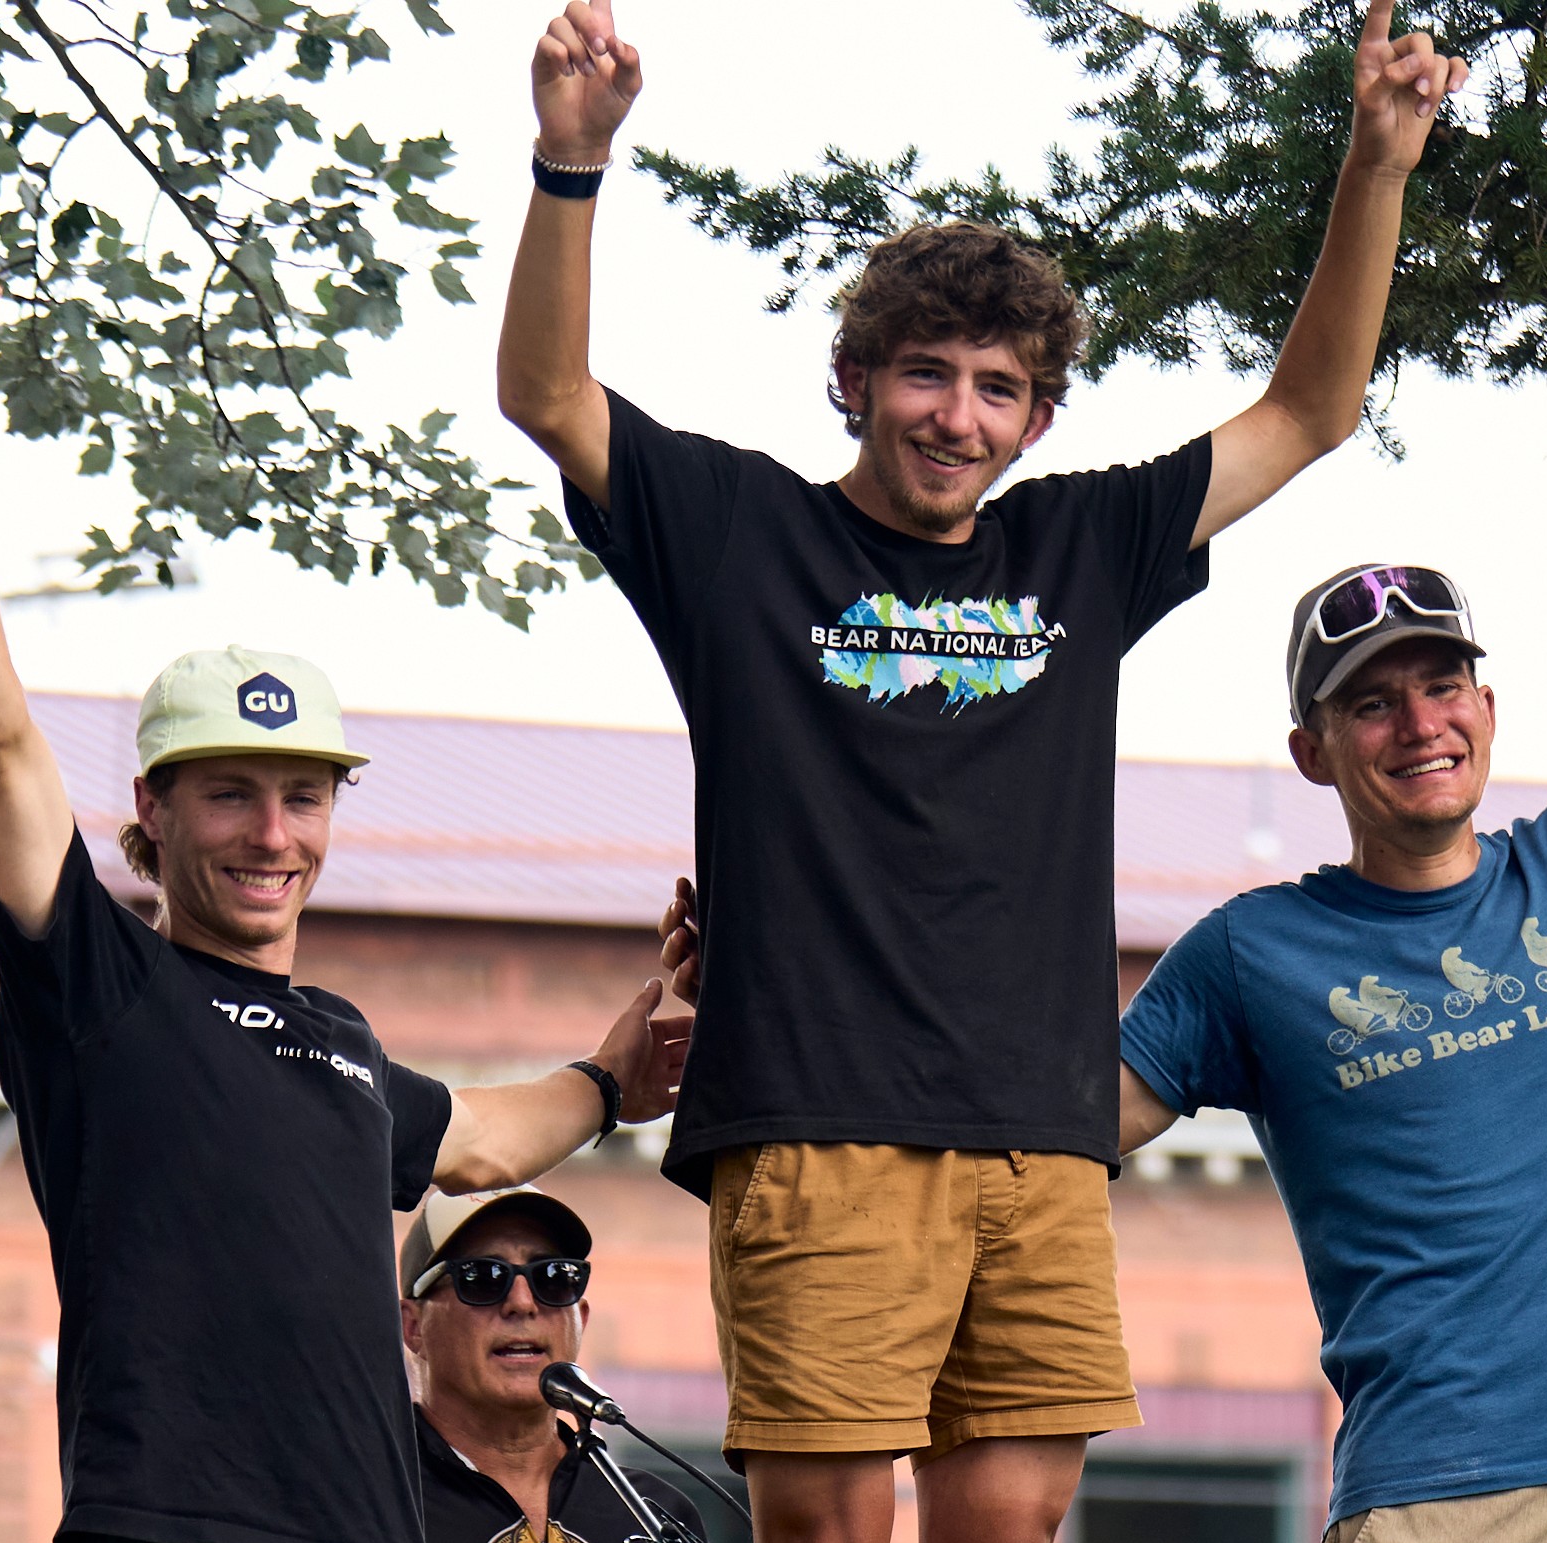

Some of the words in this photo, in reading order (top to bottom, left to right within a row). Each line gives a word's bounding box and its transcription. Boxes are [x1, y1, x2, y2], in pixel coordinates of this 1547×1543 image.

[811, 625, 879, 649] BEAR
[890, 630, 1006, 656] NATIONAL
[1013, 622, 1067, 657] TEAM
[245, 690, 289, 713] GU
[1335, 1047, 1422, 1090] Bike
[1427, 1018, 1516, 1060] Bear
